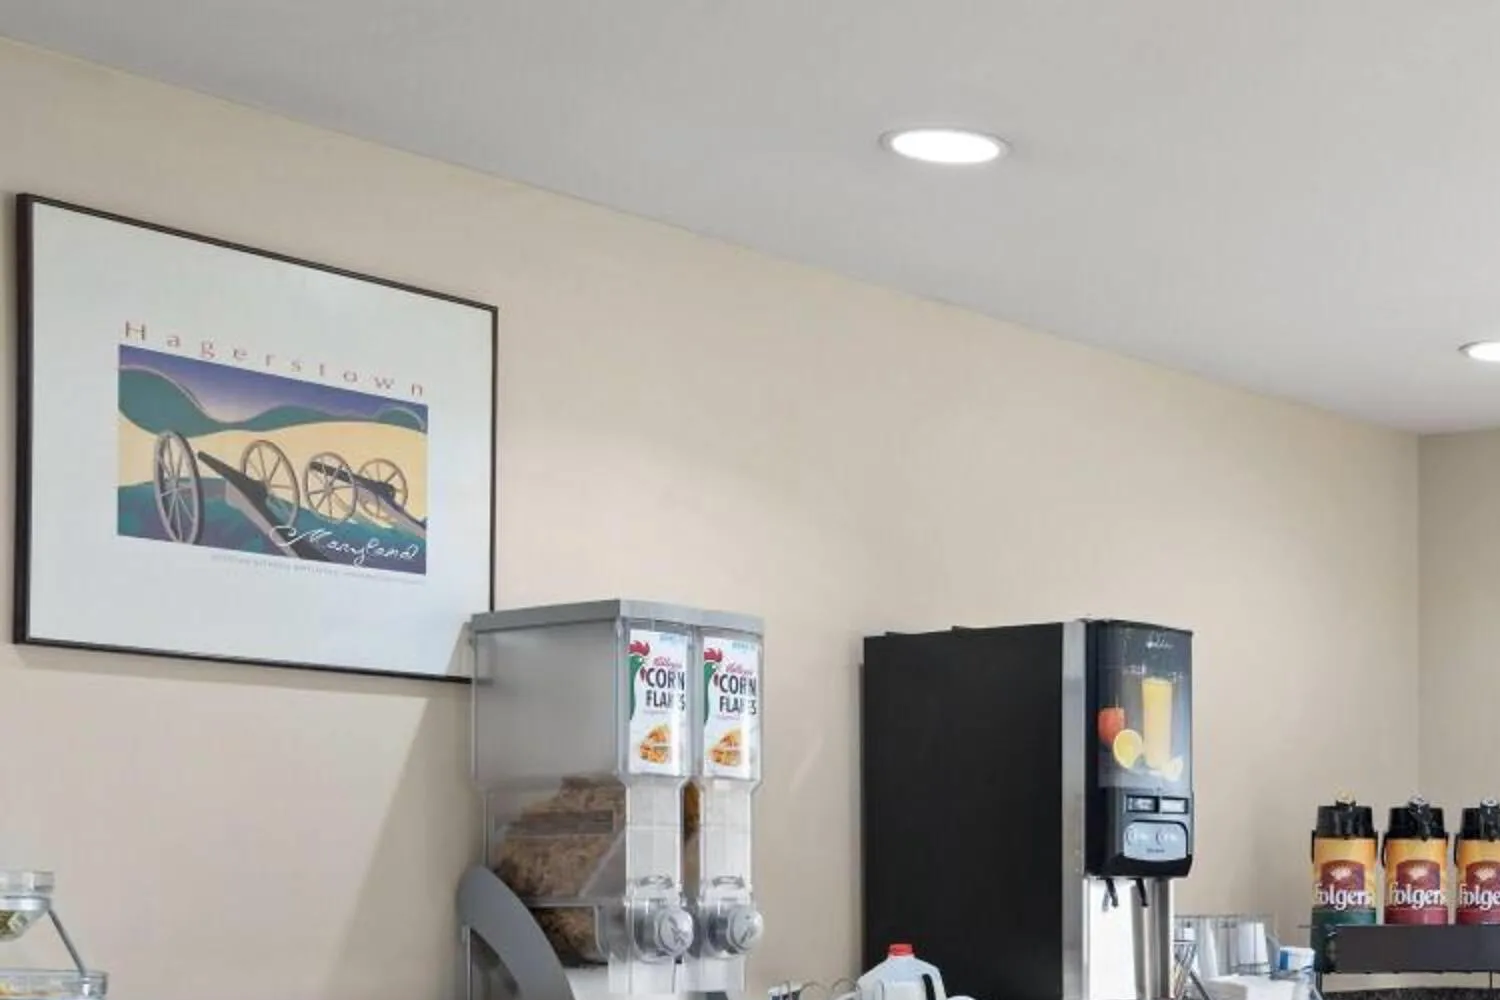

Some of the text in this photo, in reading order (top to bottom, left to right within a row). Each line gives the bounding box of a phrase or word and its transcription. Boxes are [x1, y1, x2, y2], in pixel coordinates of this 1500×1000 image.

[124, 319, 424, 397] Hagerstown
[269, 525, 419, 568] Maryland
[646, 667, 685, 691] CORN
[719, 673, 757, 697] CORN
[646, 689, 685, 711] FLAS
[719, 695, 757, 715] FLAS
